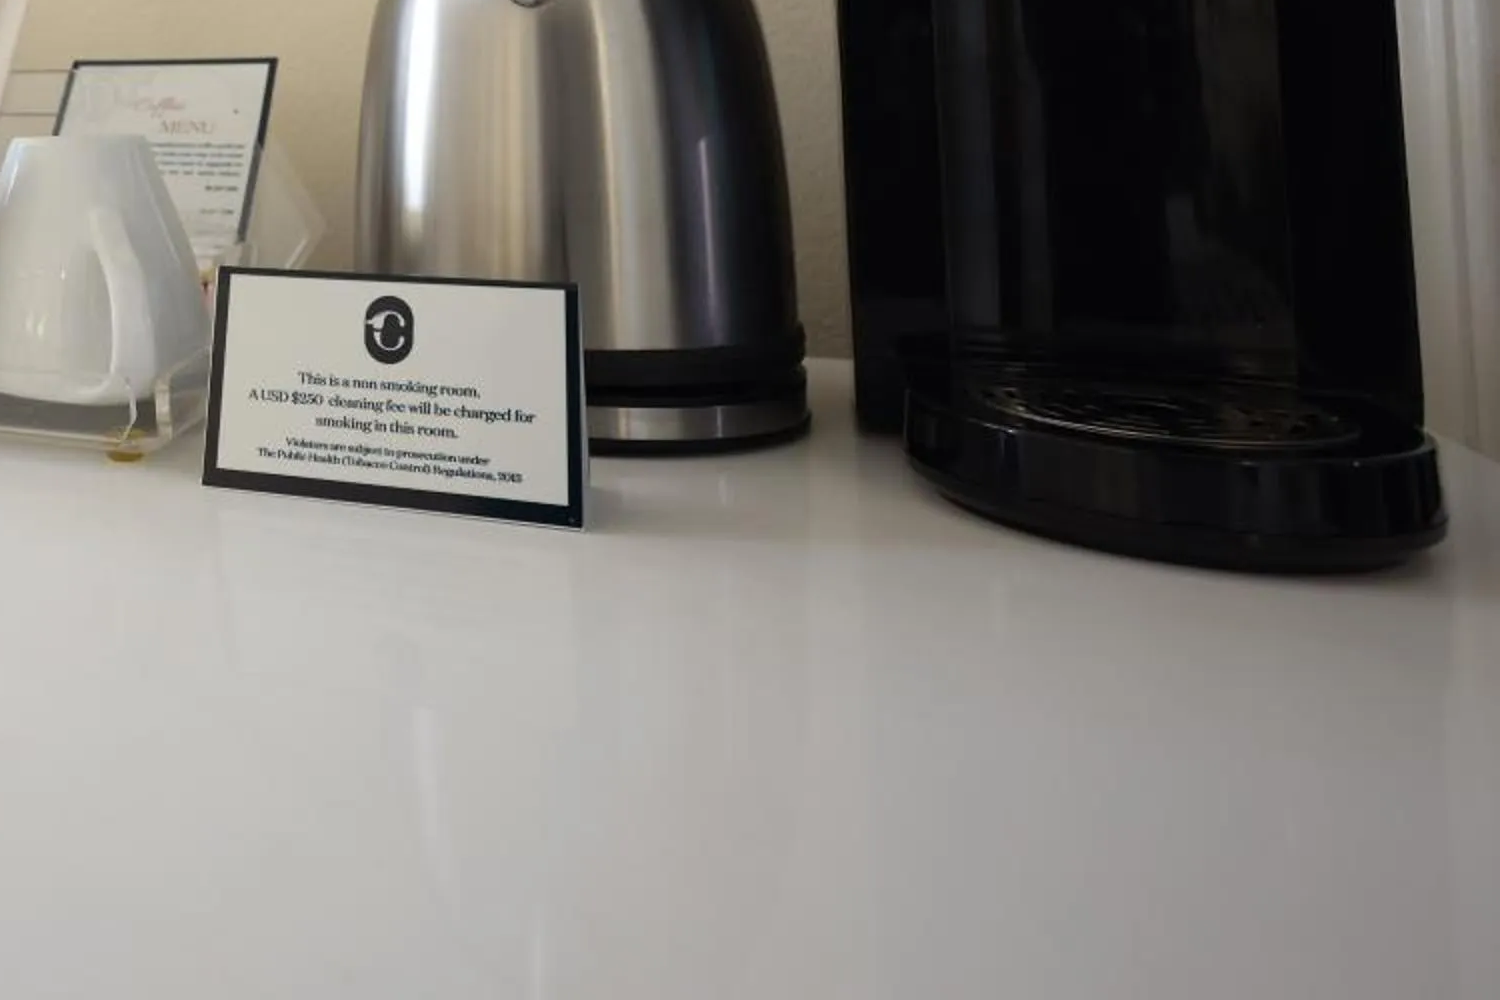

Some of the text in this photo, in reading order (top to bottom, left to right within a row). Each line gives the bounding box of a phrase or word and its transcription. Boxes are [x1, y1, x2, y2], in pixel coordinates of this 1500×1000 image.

[160, 119, 216, 135] MENU
[298, 372, 327, 386] This
[329, 374, 341, 387] is
[342, 378, 350, 388] a
[352, 378, 377, 389] non
[380, 380, 438, 399] smoking
[248, 389, 537, 424] A USD $250 cleaning fee will be charged for
[315, 416, 459, 439] smoking in this room.
[257, 447, 276, 457] The
[277, 448, 306, 461] Public
[307, 452, 341, 465] Health
[330, 442, 346, 452] are
[396, 449, 457, 463] prosecution
[458, 455, 491, 467] under
